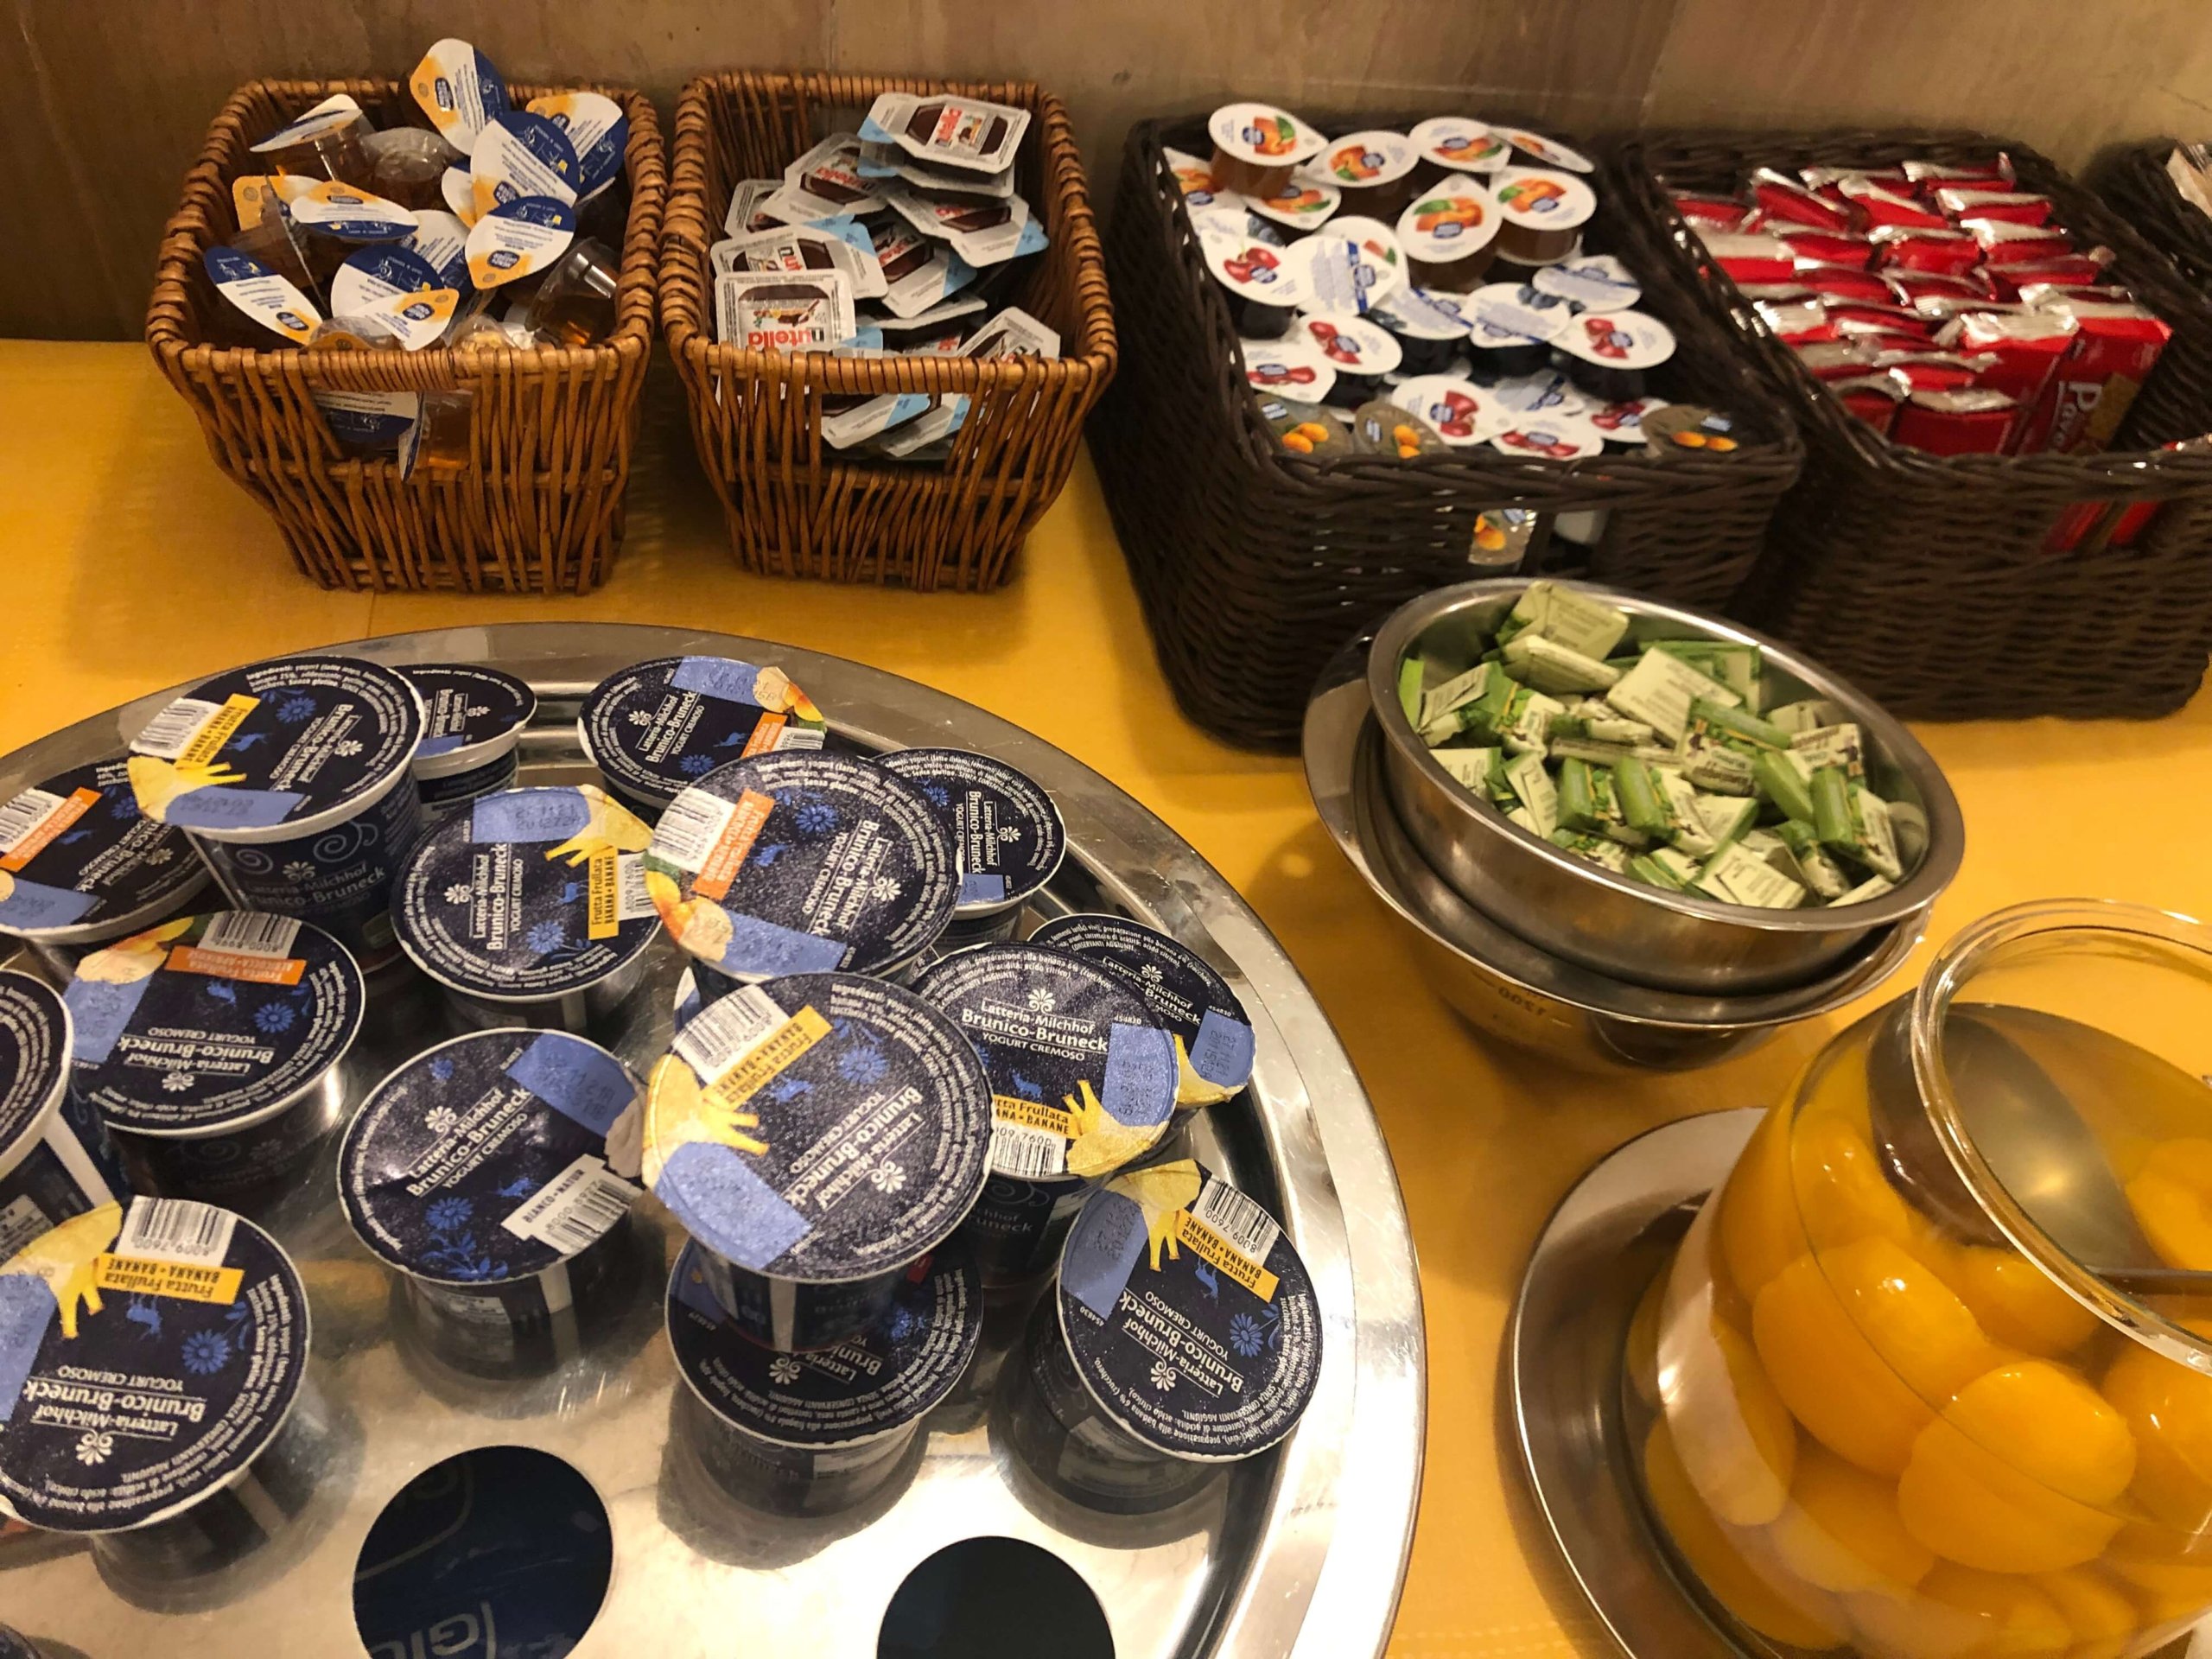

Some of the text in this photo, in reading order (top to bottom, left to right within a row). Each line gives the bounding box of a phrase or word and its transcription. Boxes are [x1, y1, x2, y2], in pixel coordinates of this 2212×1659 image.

[747, 328, 823, 346] nutella
[267, 714, 322, 782] YOGURT CREMOSO
[274, 699, 353, 796] Brunico-Bruneck
[298, 712, 359, 785] Latteria-Milchhof
[639, 694, 679, 754] Latteria-Milchhof
[645, 689, 698, 765] Brunico-Bruneck
[670, 703, 705, 756] YOGURT CREMOSO
[954, 802, 963, 830] YOGURT
[968, 790, 984, 875] Brunico-Bruneck
[982, 800, 996, 867] Latteria-Milchhof
[473, 853, 489, 938] Latteria-Milchhof
[486, 841, 509, 951] Brunico-Bruneck
[509, 858, 524, 932] YOGURT CREMOSO
[589, 857, 606, 925] Frutta Frullata
[602, 855, 615, 925] BANANA BANANE
[800, 830, 849, 915] YOGURT CREMOSO
[810, 818, 879, 939] Brunico-Bruneck
[835, 834, 887, 930] Latteria-Milchhof
[1101, 956, 1192, 1011] Latteria-Milchhof
[148, 1026, 256, 1046] YOGURT CREMOSO
[961, 1007, 1108, 1052] Brunico-Bruneck
[980, 1002, 1096, 1034] Latteria-Milchhof
[1154, 1003, 1183, 1022] MOSO
[117, 1034, 274, 1065] Brunico-Bruneck
[127, 1051, 251, 1075] Latteria-Milchhof
[760, 1020, 803, 1059] BANANA
[981, 1032, 1084, 1061] YOGURT CREMOSO
[724, 1030, 812, 1107] Frutta Frullata
[408, 1087, 505, 1181] Latteria-Milchhof
[787, 1089, 885, 1176] YOGURT CREMOSO
[1019, 1103, 1069, 1123] Frullata
[1021, 1132, 1052, 1147] 7600
[1027, 1115, 1069, 1134] BANANE
[407, 1084, 531, 1198] Brunico-Bruneck
[441, 1109, 529, 1192] YOGURT CREMOSO
[782, 1084, 923, 1209] Brunico-Bruneck
[813, 1109, 923, 1208] Latteria-Milchhof
[522, 1166, 586, 1224] BIANCO NATUR
[1178, 1227, 1224, 1264] Frullata
[1183, 1217, 1262, 1278] BANANA BANANE
[1203, 1208, 1258, 1254] 8009 7600
[104, 1270, 213, 1299] Frutta Frullata
[105, 1257, 220, 1284] BANANA BANANE
[1219, 1257, 1258, 1289] Frutta
[1078, 1305, 1105, 1326] 454830
[1116, 1292, 1246, 1392] Brunico-Bruneck
[1142, 1290, 1231, 1360] YOGURT CREMOSO
[56, 1363, 183, 1395] YOGURT CREMOSO
[1091, 1356, 1122, 1396] (zucchero,
[1122, 1317, 1224, 1396] Latteria-Milchhof
[22, 1376, 206, 1424] Brunico-Bruneck
[34, 1402, 178, 1439] Latteria-Milchhof
[1116, 1393, 1132, 1408] 6%
[1124, 1386, 1154, 1412] citrico),
[1127, 1404, 1158, 1428] banana
[1156, 1421, 1173, 1436] alla
[1172, 1428, 1220, 1443] preparazione
